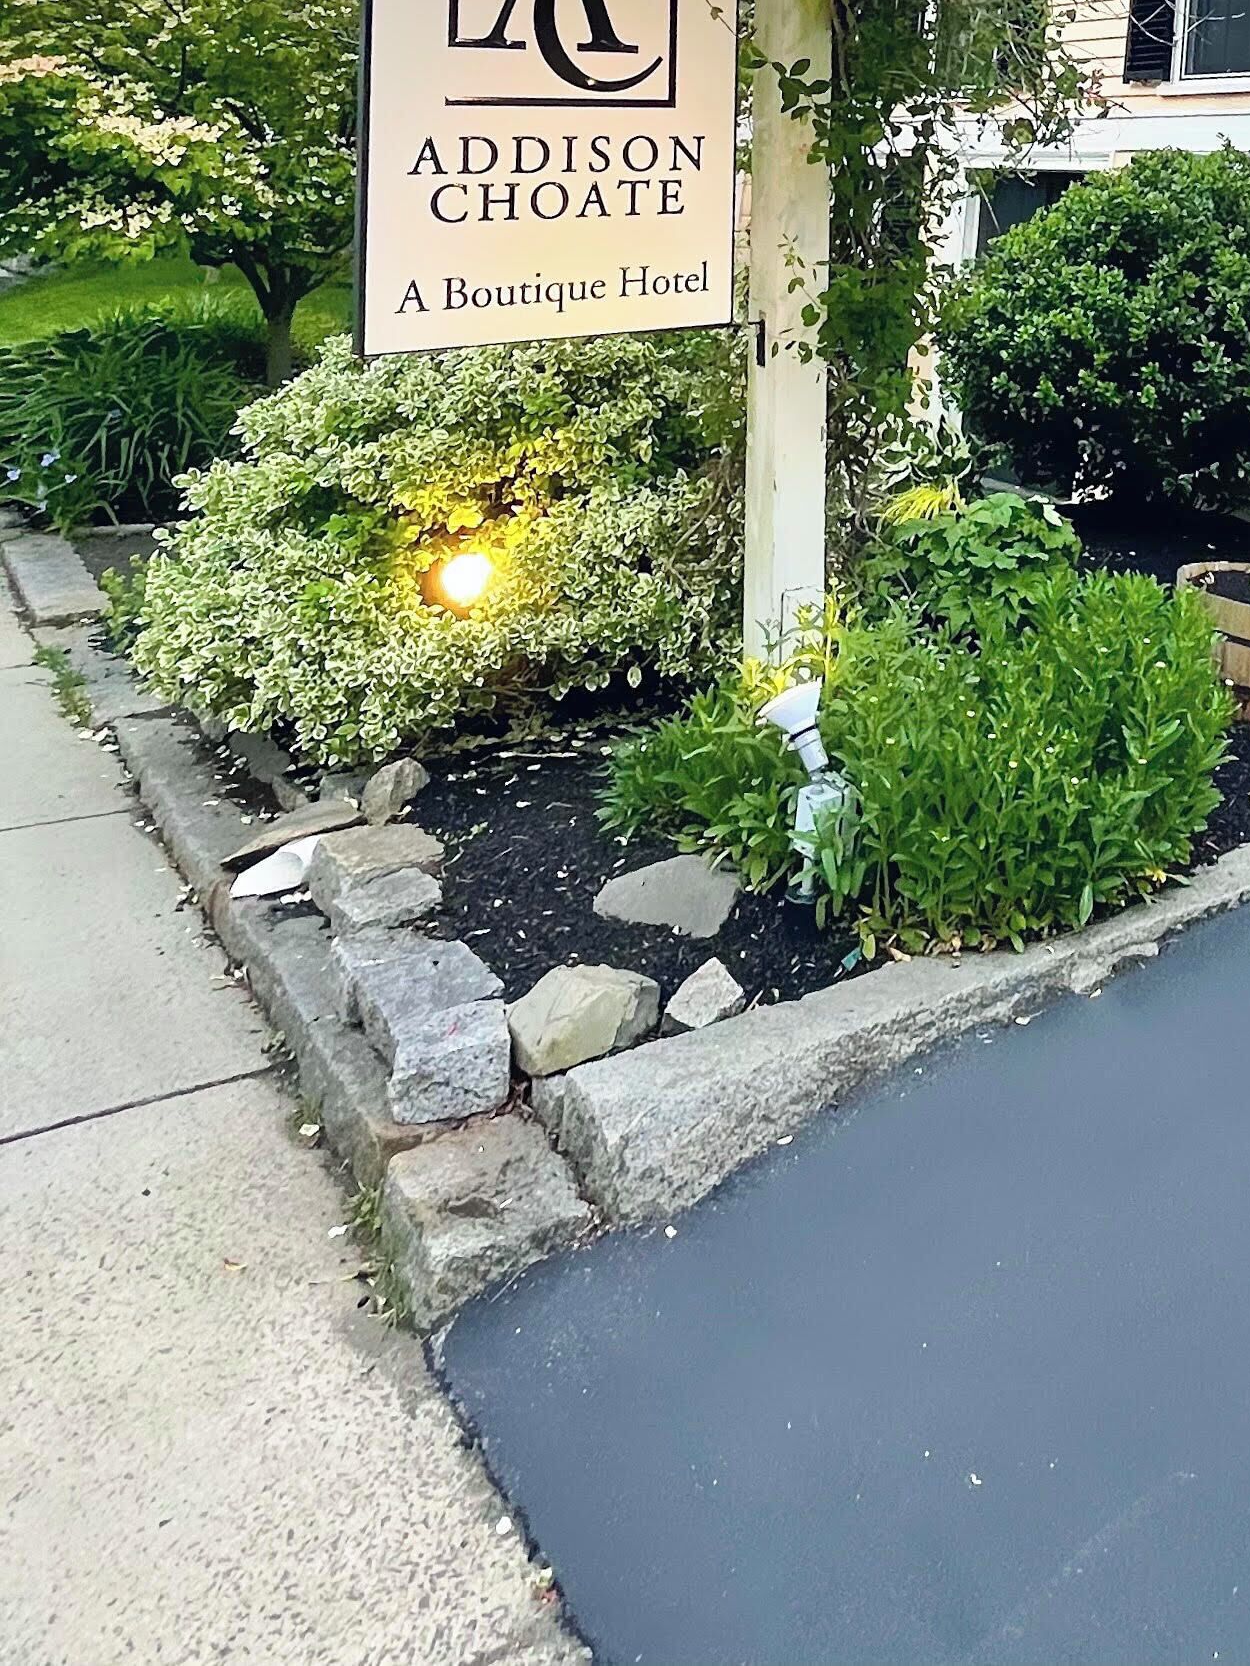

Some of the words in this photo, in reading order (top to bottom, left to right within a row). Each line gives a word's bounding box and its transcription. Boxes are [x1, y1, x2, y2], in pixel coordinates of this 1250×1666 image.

[407, 136, 706, 175] ADDISON
[431, 180, 685, 223] CHOATE
[395, 280, 429, 313] A
[443, 273, 606, 312] Boutique
[620, 261, 709, 297] Hotel
